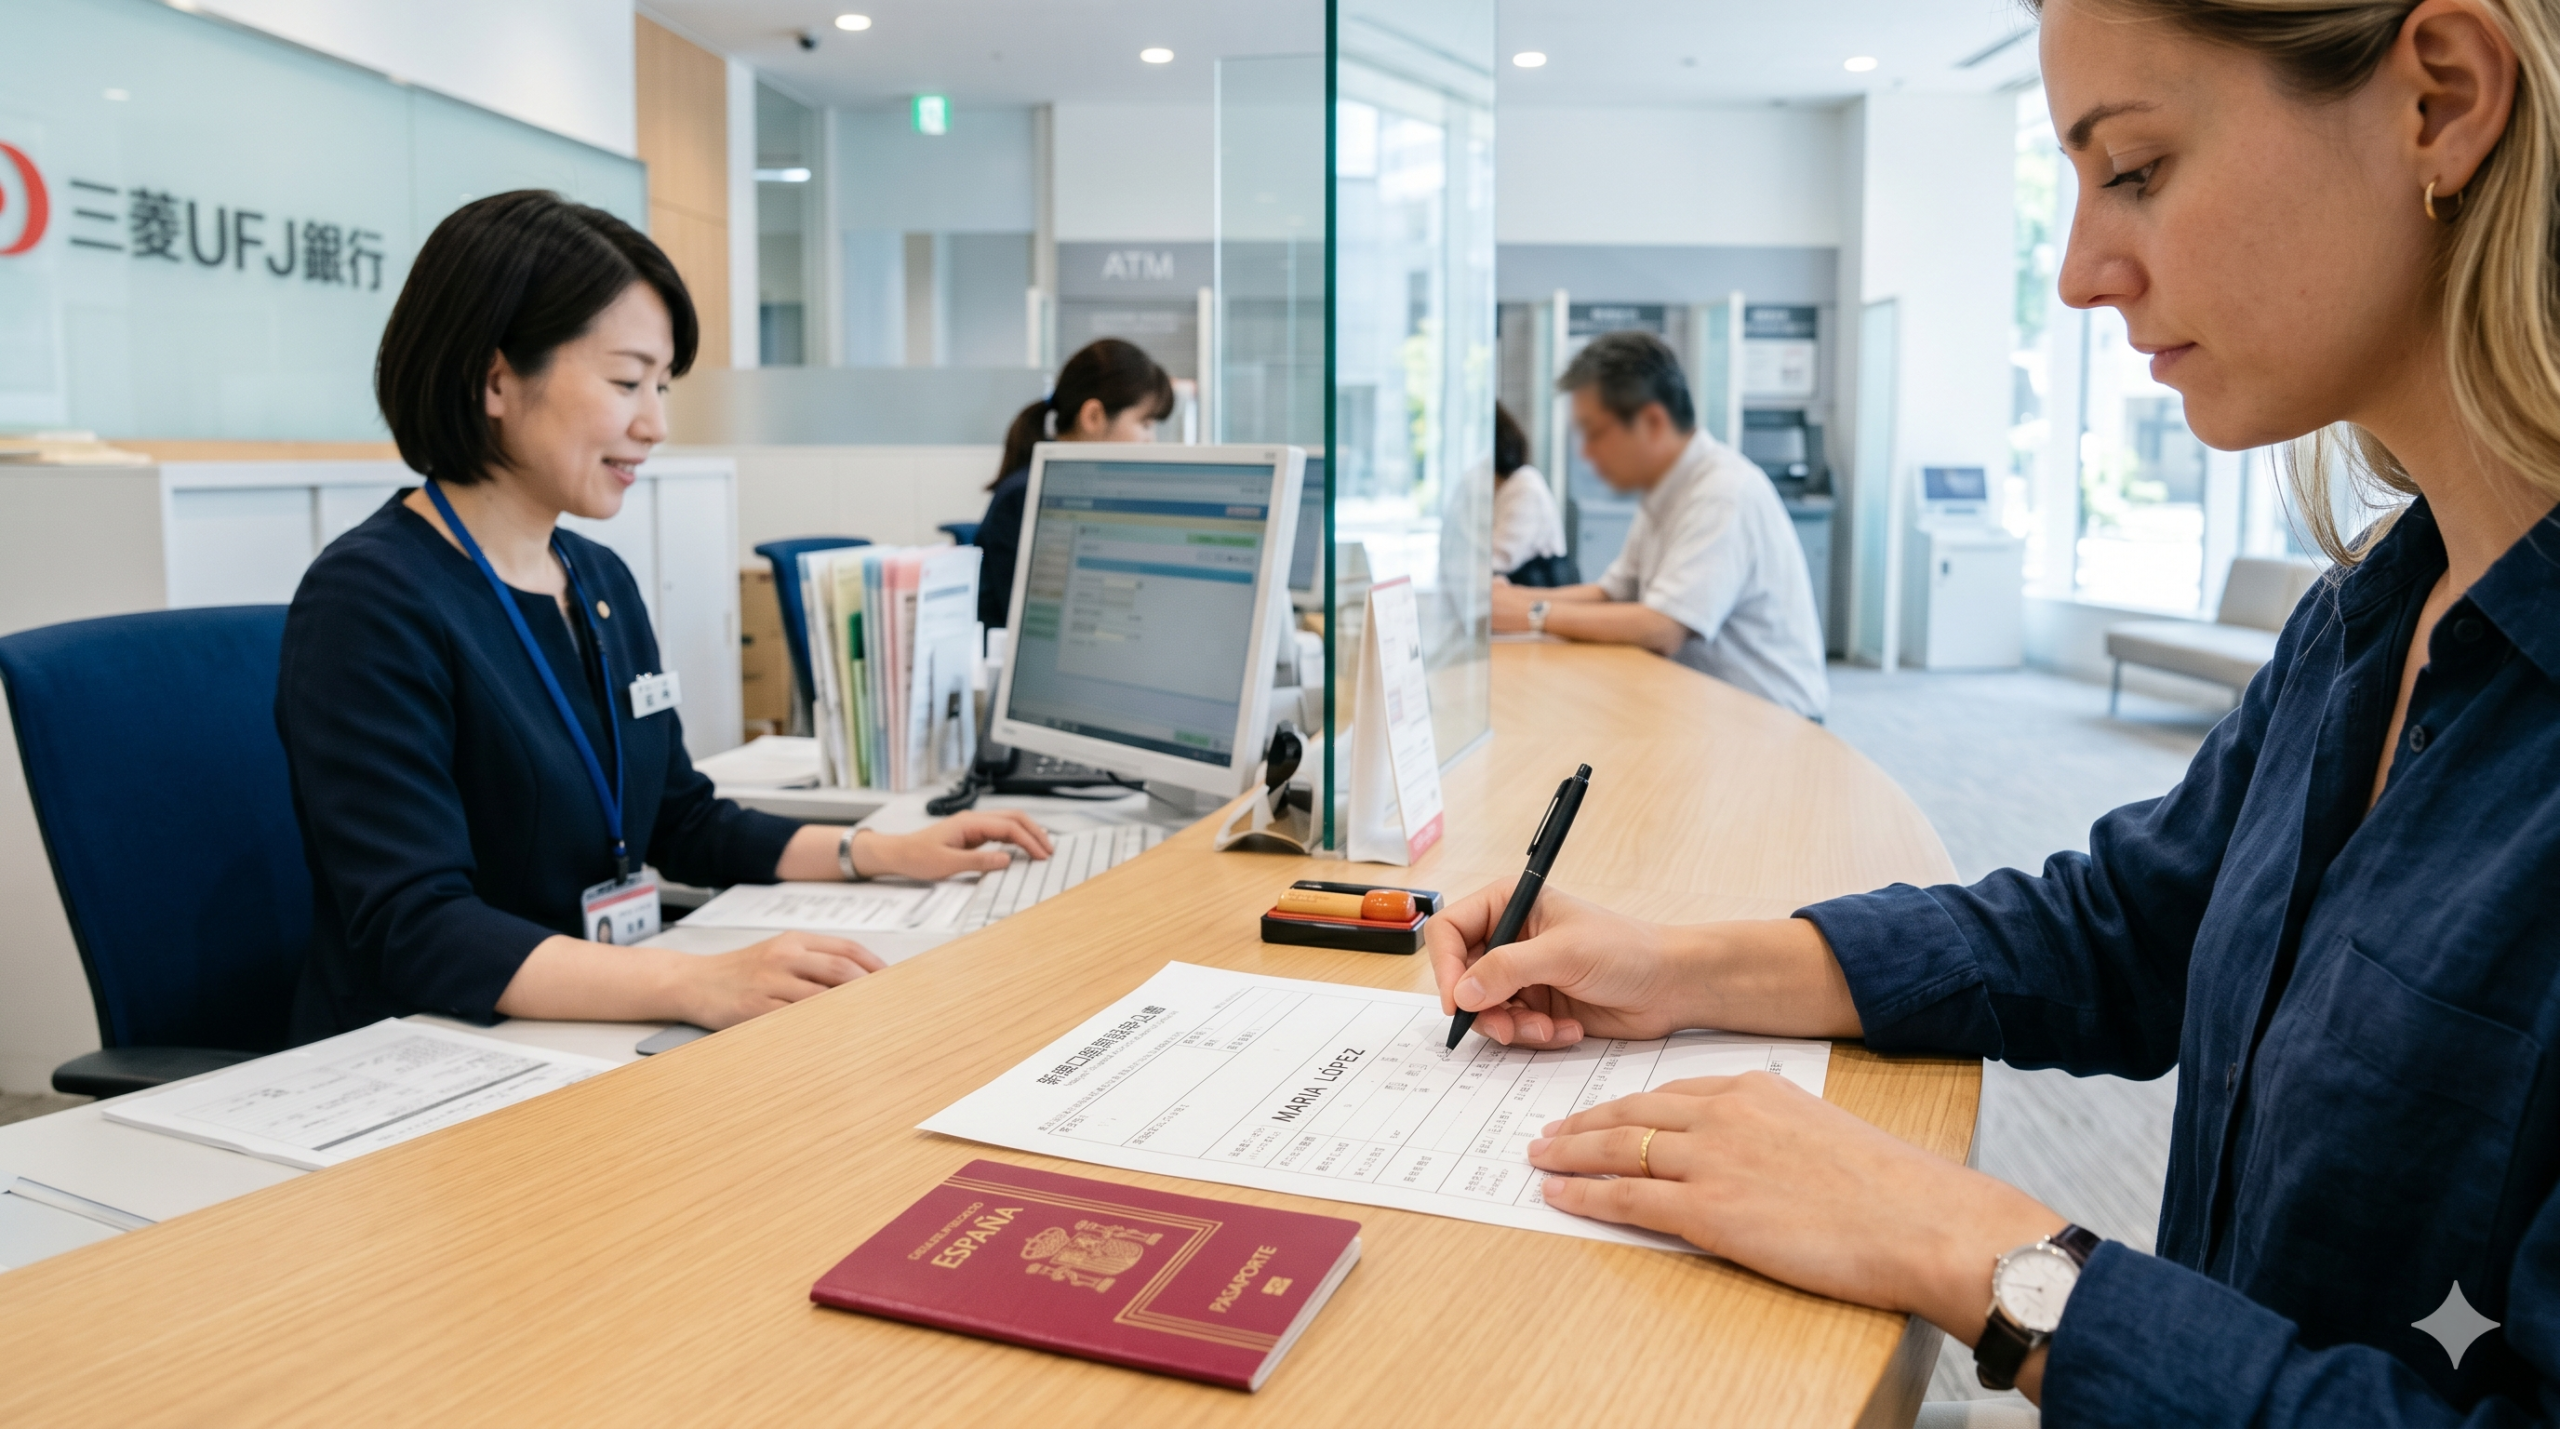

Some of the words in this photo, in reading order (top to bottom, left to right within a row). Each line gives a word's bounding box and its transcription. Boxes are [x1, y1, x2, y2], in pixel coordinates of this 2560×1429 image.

[69, 177, 385, 292] 三菱UFJ銀行
[1100, 250, 1174, 280] ATM
[1271, 1087, 1328, 1122] MARIA
[1313, 1047, 1366, 1082] LÓPEZ
[930, 1207, 1024, 1269] ESPAÑA
[1208, 1245, 1278, 1313] PASAPORTE
